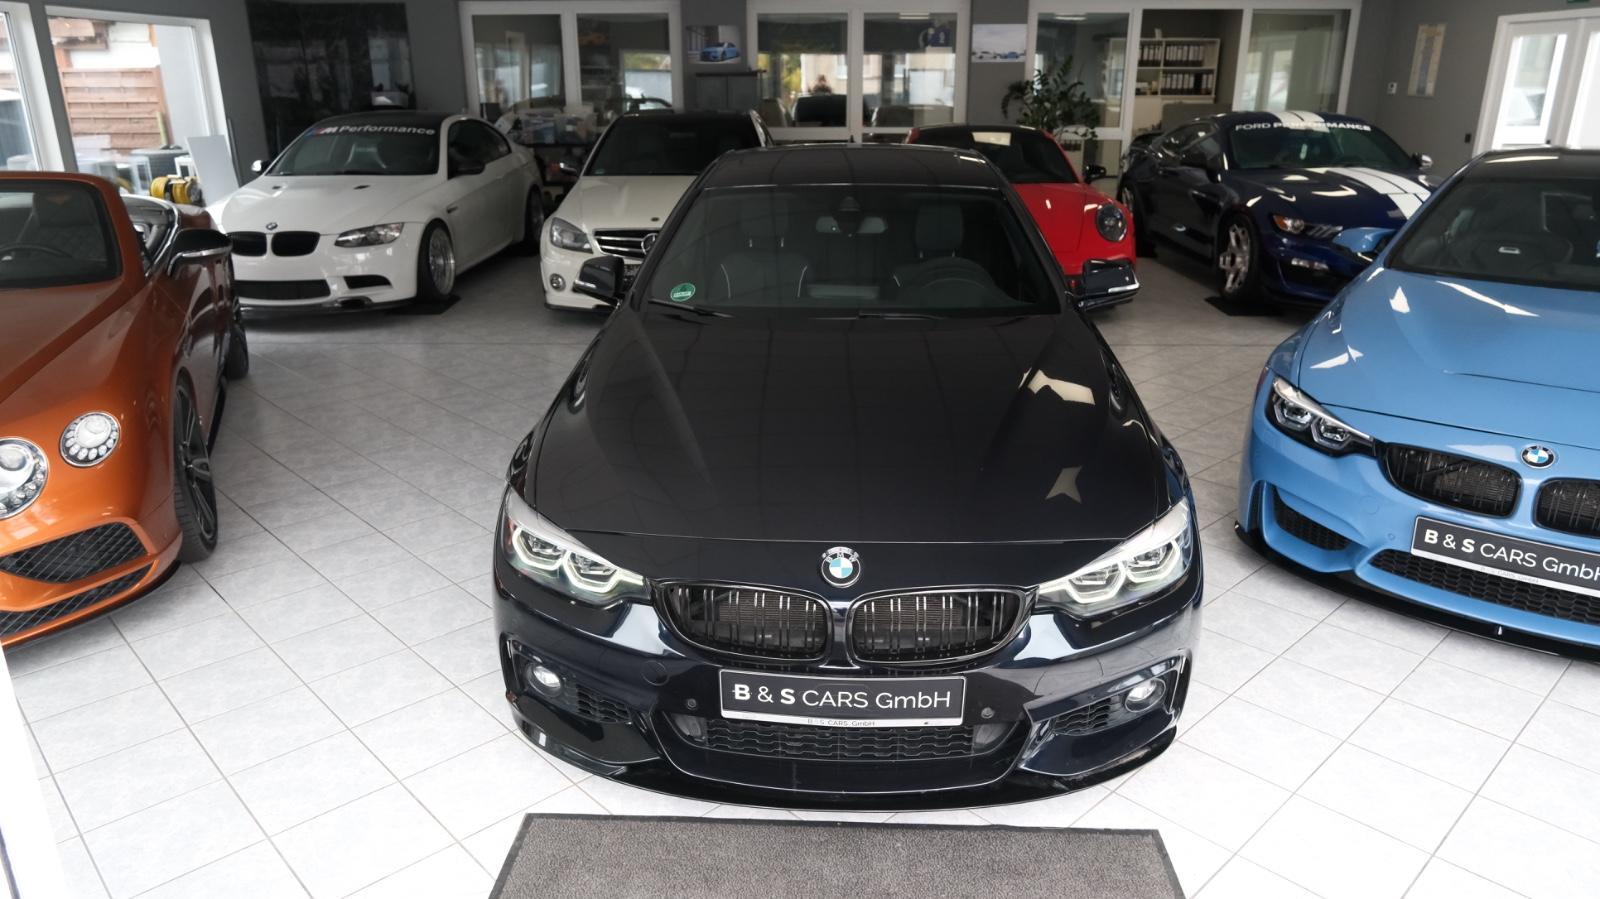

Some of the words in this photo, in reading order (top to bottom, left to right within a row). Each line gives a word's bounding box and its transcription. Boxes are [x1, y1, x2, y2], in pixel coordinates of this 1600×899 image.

[340, 125, 436, 136] Performance
[1235, 121, 1271, 131] FORD
[1424, 529, 1438, 545] B
[1442, 533, 1456, 549] &
[1461, 538, 1476, 553] S
[1480, 543, 1537, 568] CARS
[734, 684, 750, 701] B
[757, 685, 774, 704] &
[780, 688, 796, 705] S
[802, 690, 869, 709] CARS
[876, 691, 951, 709] GmbH
